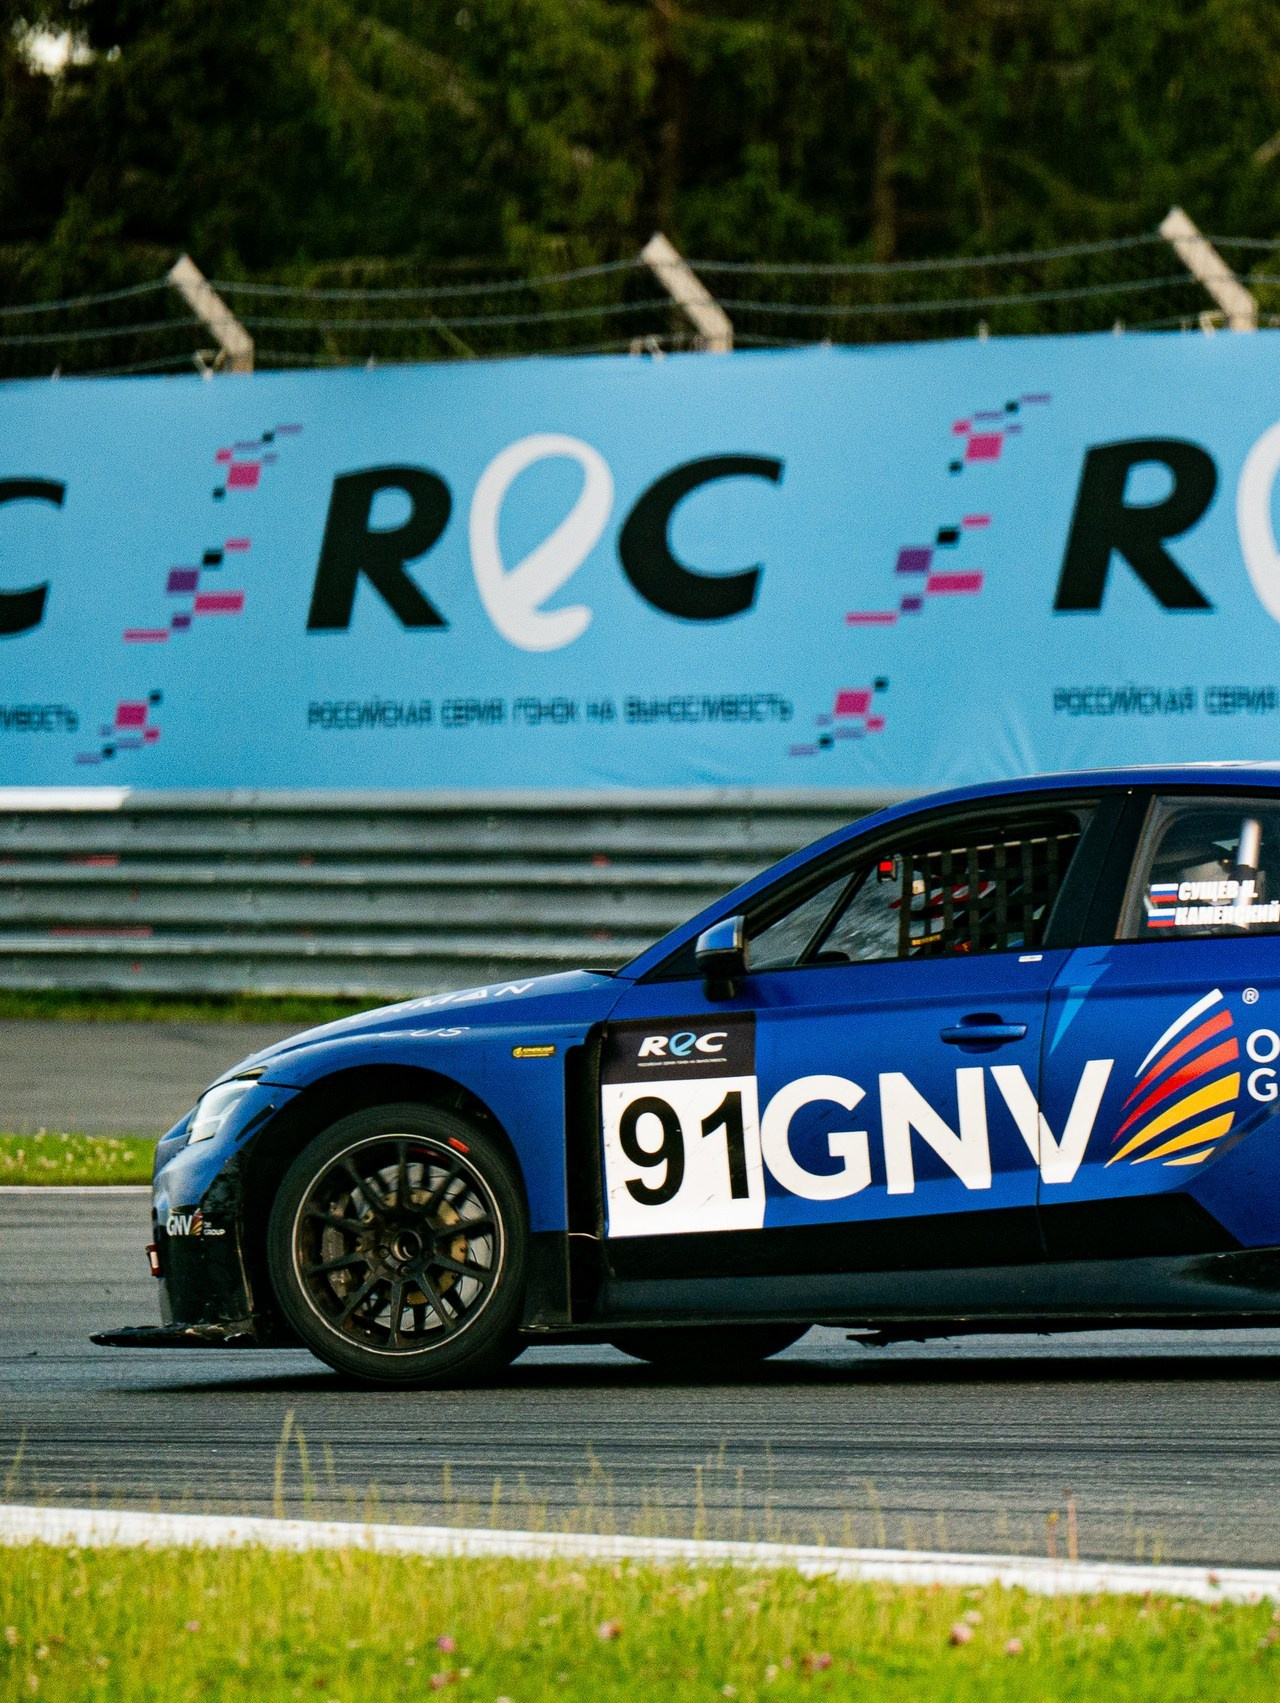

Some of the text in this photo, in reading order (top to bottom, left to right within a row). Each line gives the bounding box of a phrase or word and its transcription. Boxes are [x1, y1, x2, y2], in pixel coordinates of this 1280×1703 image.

[618, 1090, 750, 1206] 91
[760, 1058, 1115, 1200] GNV
[166, 1215, 193, 1236] GNV
